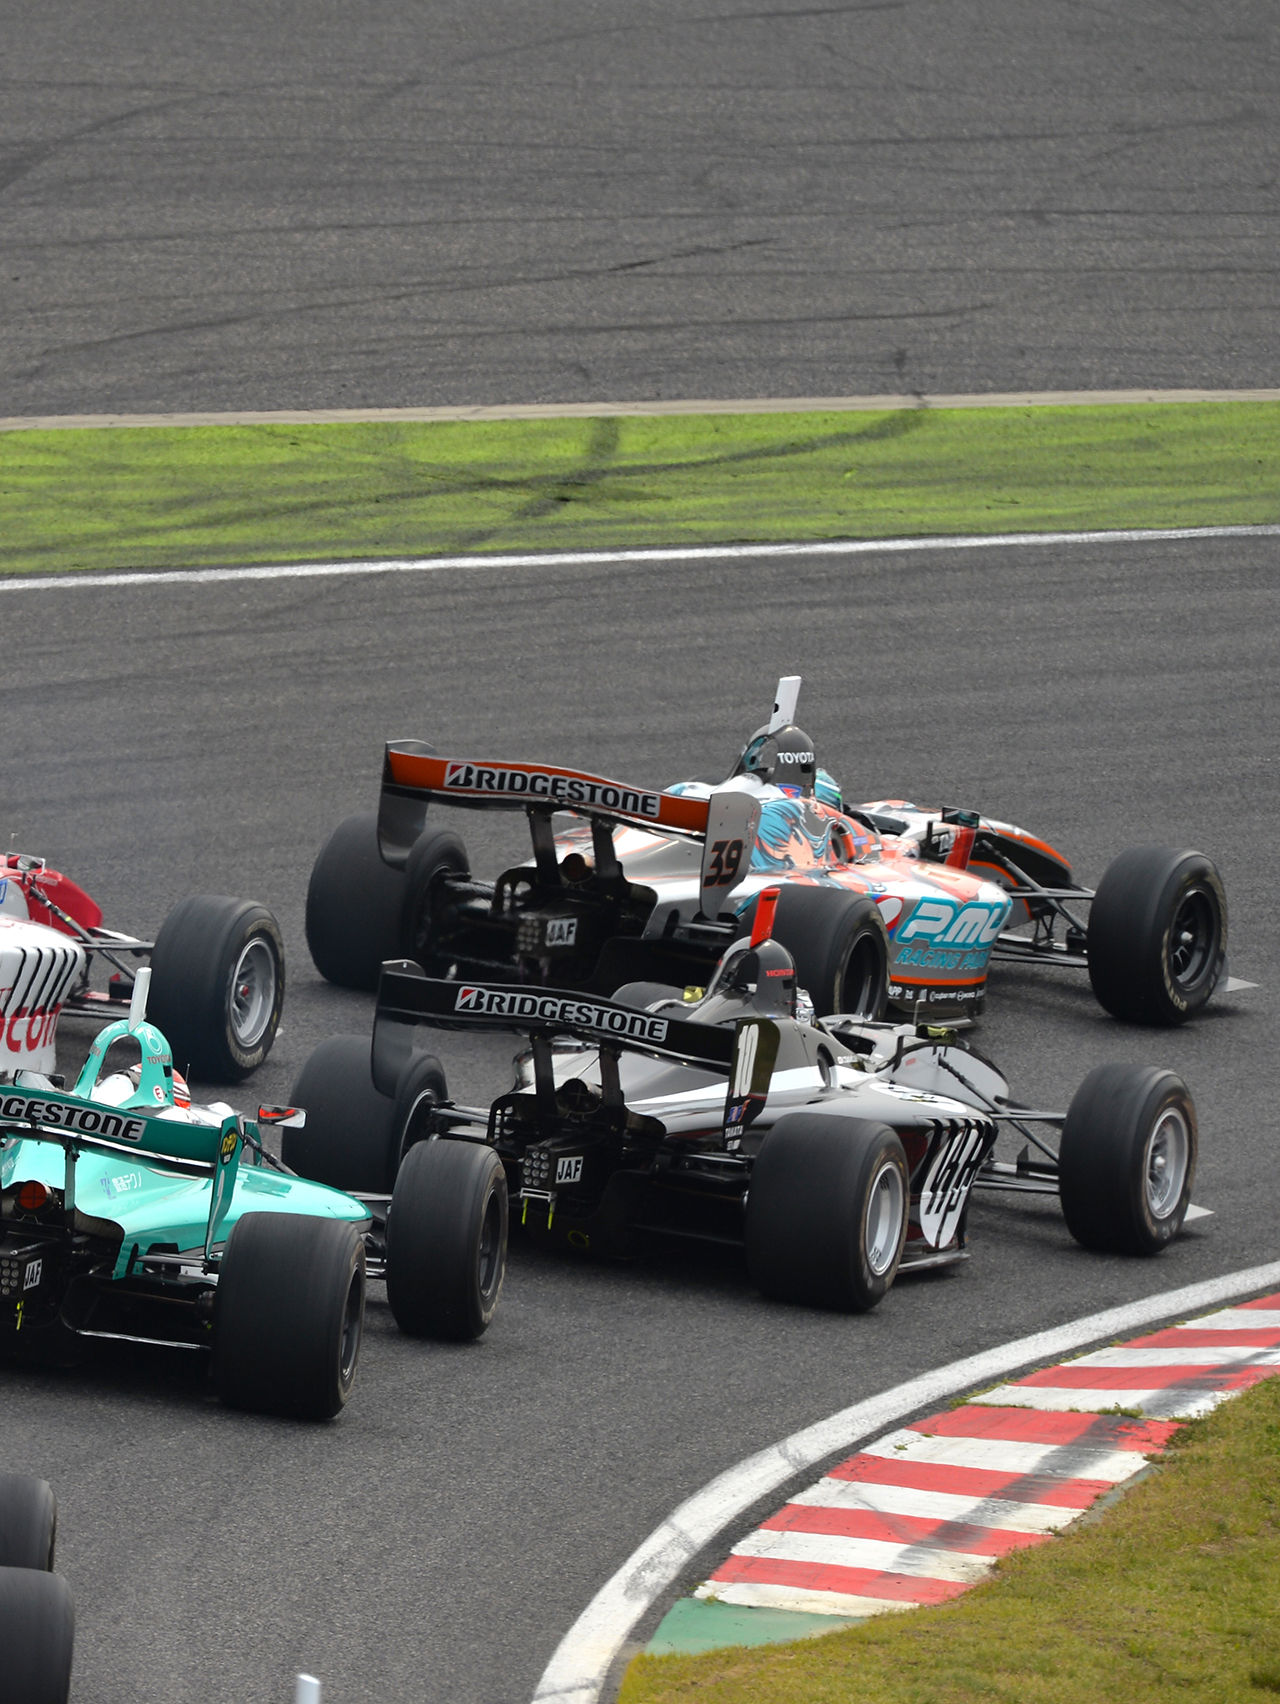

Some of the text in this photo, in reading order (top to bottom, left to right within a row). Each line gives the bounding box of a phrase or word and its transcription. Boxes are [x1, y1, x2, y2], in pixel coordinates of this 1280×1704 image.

[447, 763, 658, 816] BRIDGESTONE
[702, 838, 744, 888] 39
[548, 922, 576, 942] JAF
[895, 948, 959, 970] RACING
[458, 988, 668, 1042] BRIDGESTONE
[732, 1023, 760, 1098] 10
[558, 1160, 582, 1181] JAF
[24, 1261, 42, 1287] JAF
